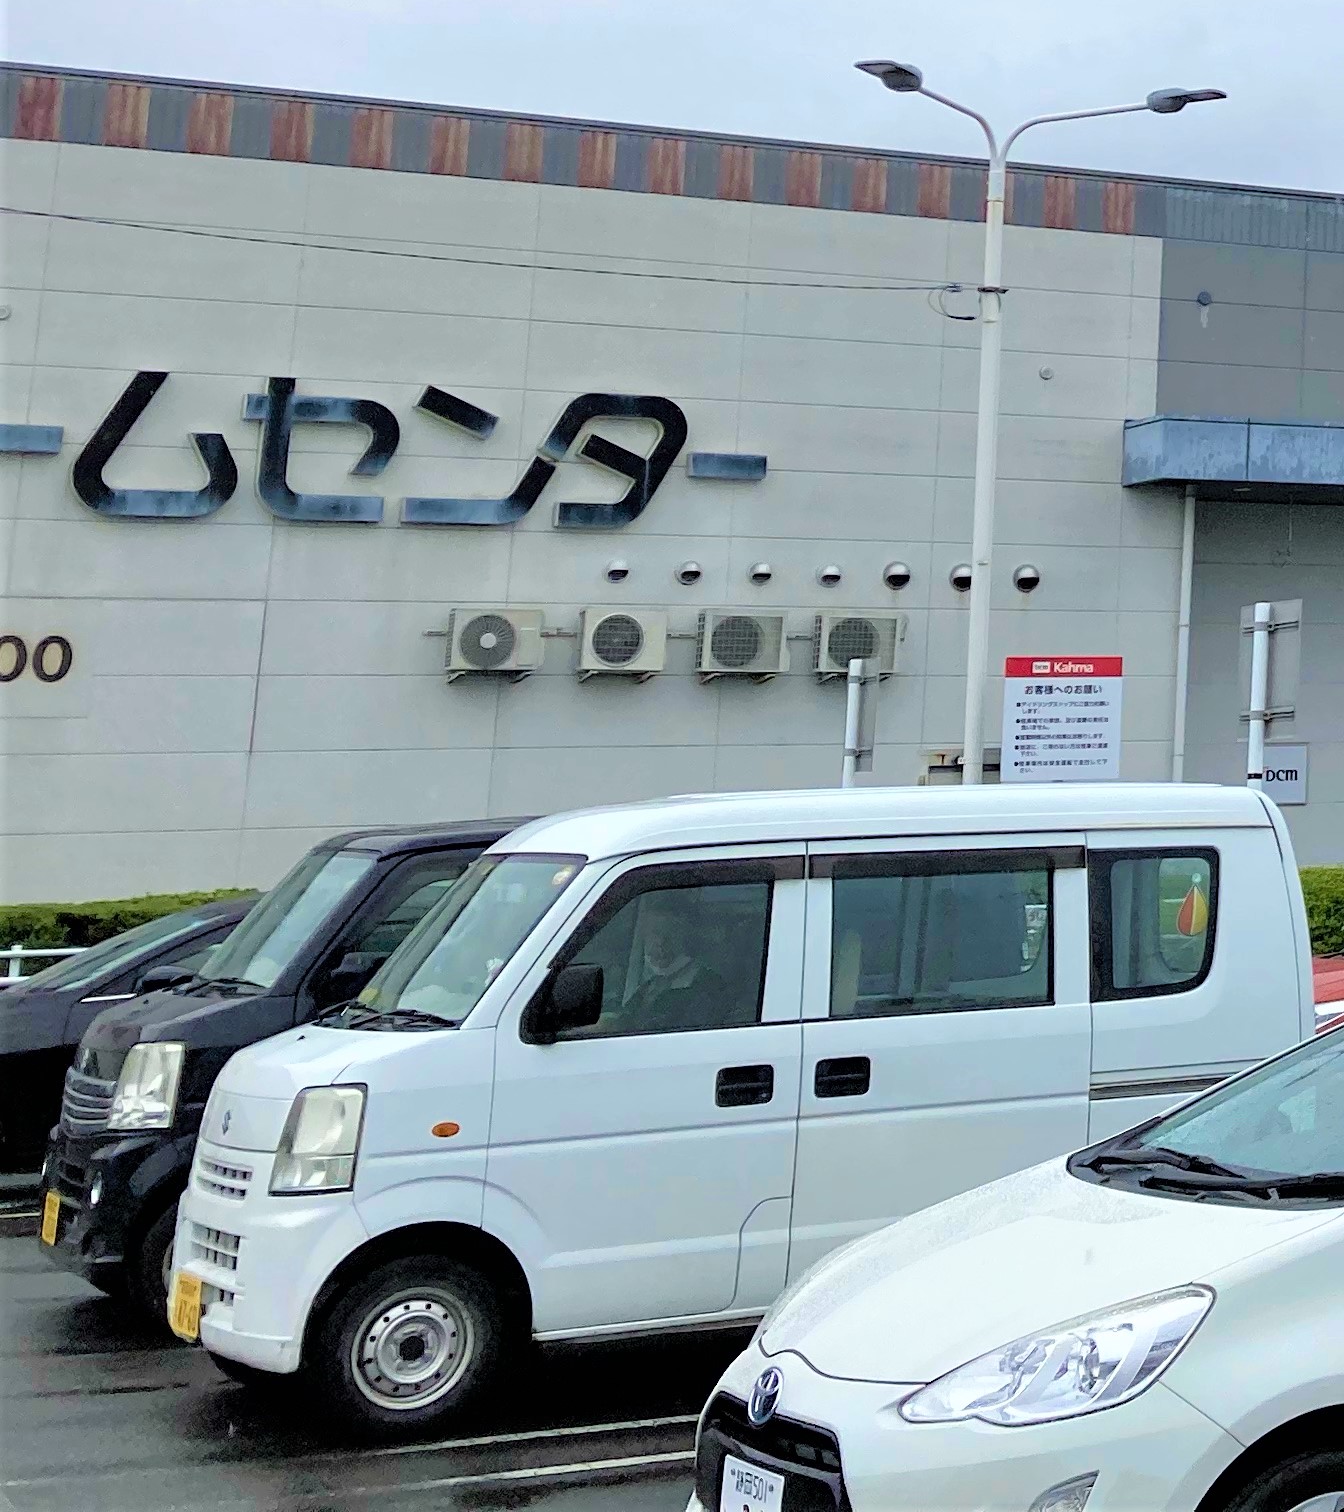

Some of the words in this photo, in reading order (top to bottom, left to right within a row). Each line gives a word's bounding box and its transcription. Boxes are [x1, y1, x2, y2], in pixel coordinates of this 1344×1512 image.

[1053, 661, 1094, 673] Kahma
[1024, 684, 1103, 695] お客様へのお願い
